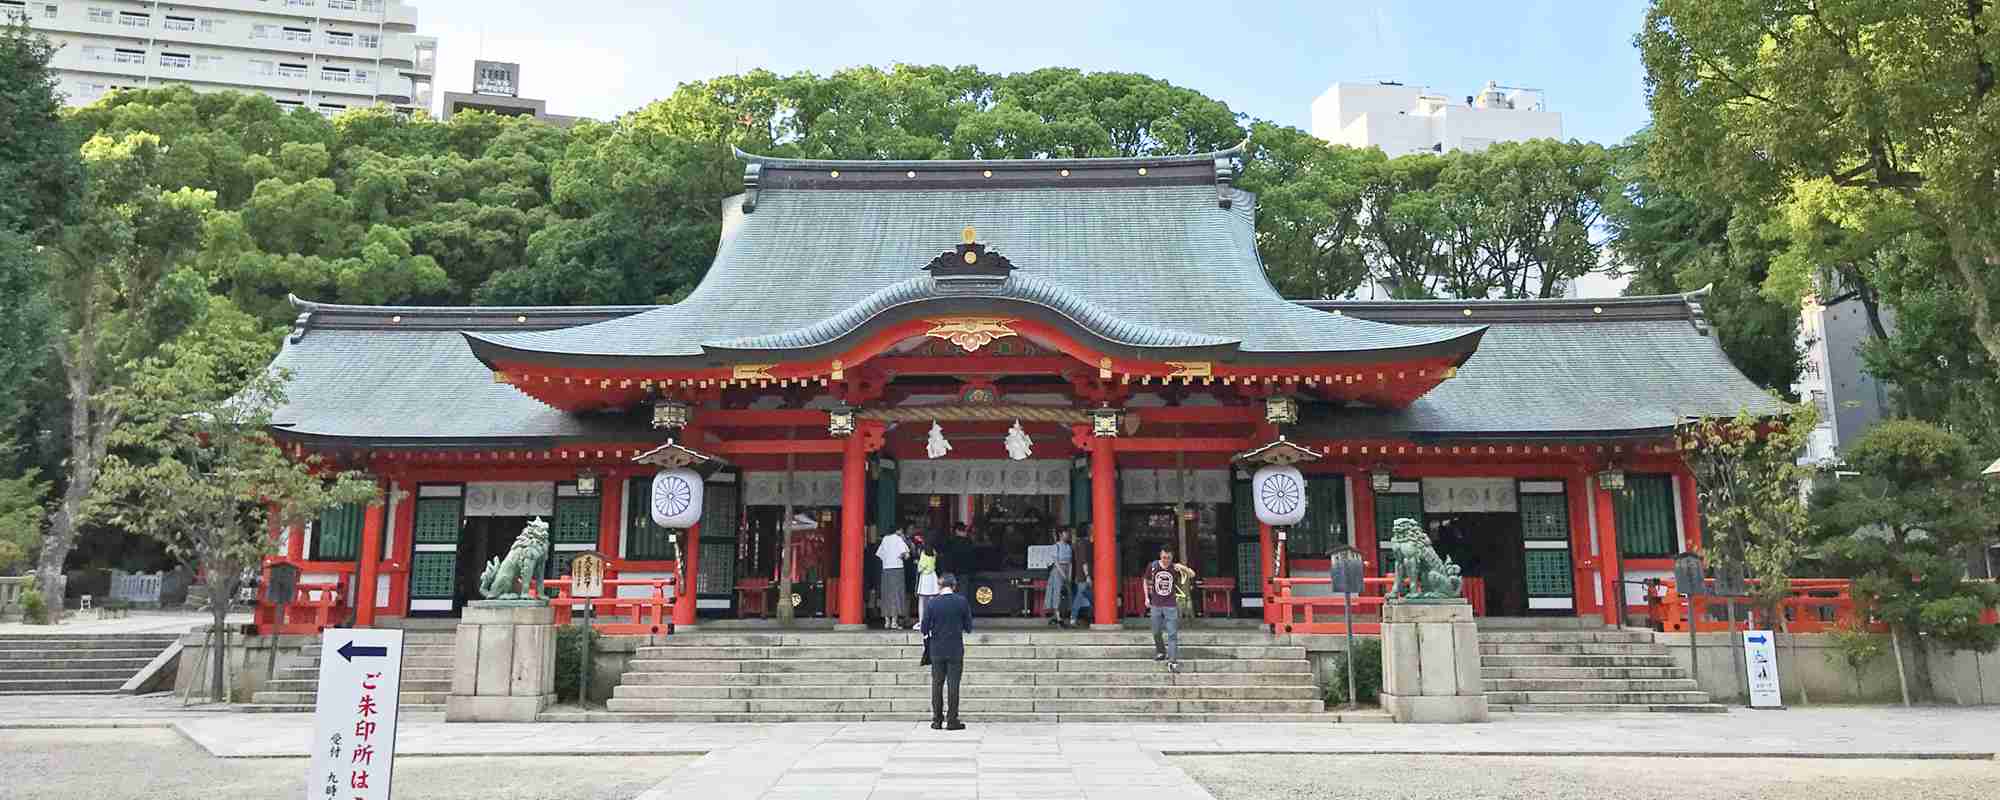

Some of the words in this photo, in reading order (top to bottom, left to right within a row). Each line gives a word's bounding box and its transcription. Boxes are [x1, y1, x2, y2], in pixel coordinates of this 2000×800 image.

[351, 672, 382, 800] ご朱印所は
[325, 771, 339, 800] 九時
